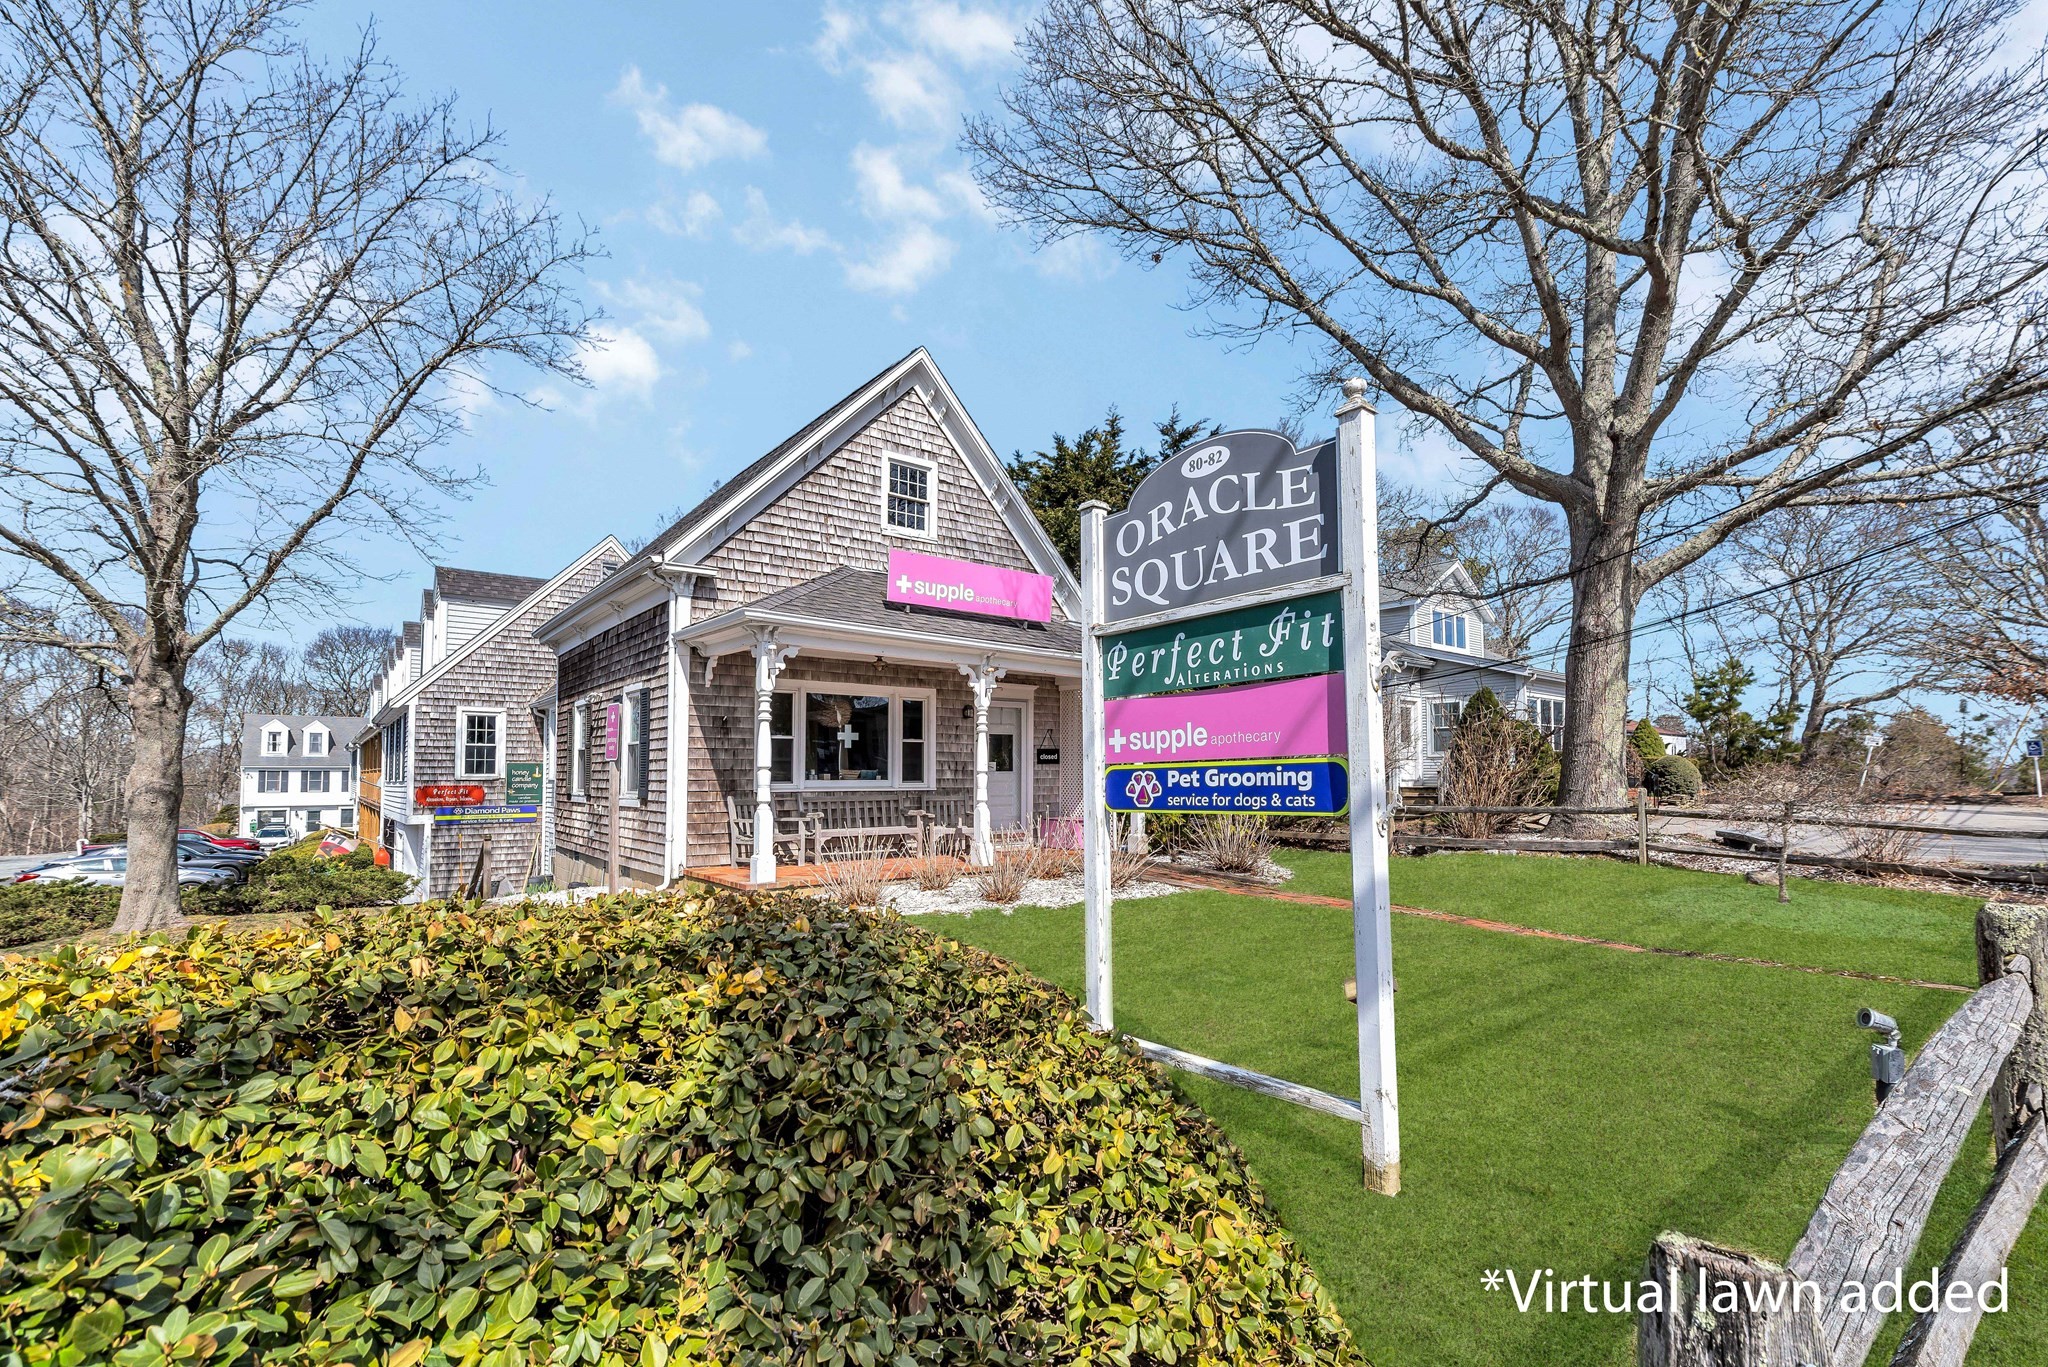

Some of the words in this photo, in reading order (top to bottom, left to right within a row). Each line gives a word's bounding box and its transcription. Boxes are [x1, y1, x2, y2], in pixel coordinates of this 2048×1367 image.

[1188, 449, 1223, 473] 80-82
[1116, 464, 1316, 557] ORACLE
[1112, 514, 1328, 605] SQUARE
[914, 580, 975, 602] supple
[975, 594, 1018, 609] apothecary
[1107, 629, 1243, 684] Perfect
[1259, 606, 1335, 656] Fit
[1129, 722, 1208, 754] supple
[1210, 731, 1281, 746] apothecary
[1167, 769, 1200, 788] Pet
[1204, 765, 1313, 791] Grooming
[432, 788, 457, 796] Perfect
[1167, 794, 1209, 807] service
[1212, 793, 1232, 807] for
[1233, 793, 1268, 810] dogs
[1271, 794, 1282, 807] &
[1285, 795, 1316, 807] cats
[464, 806, 500, 814] Diamond
